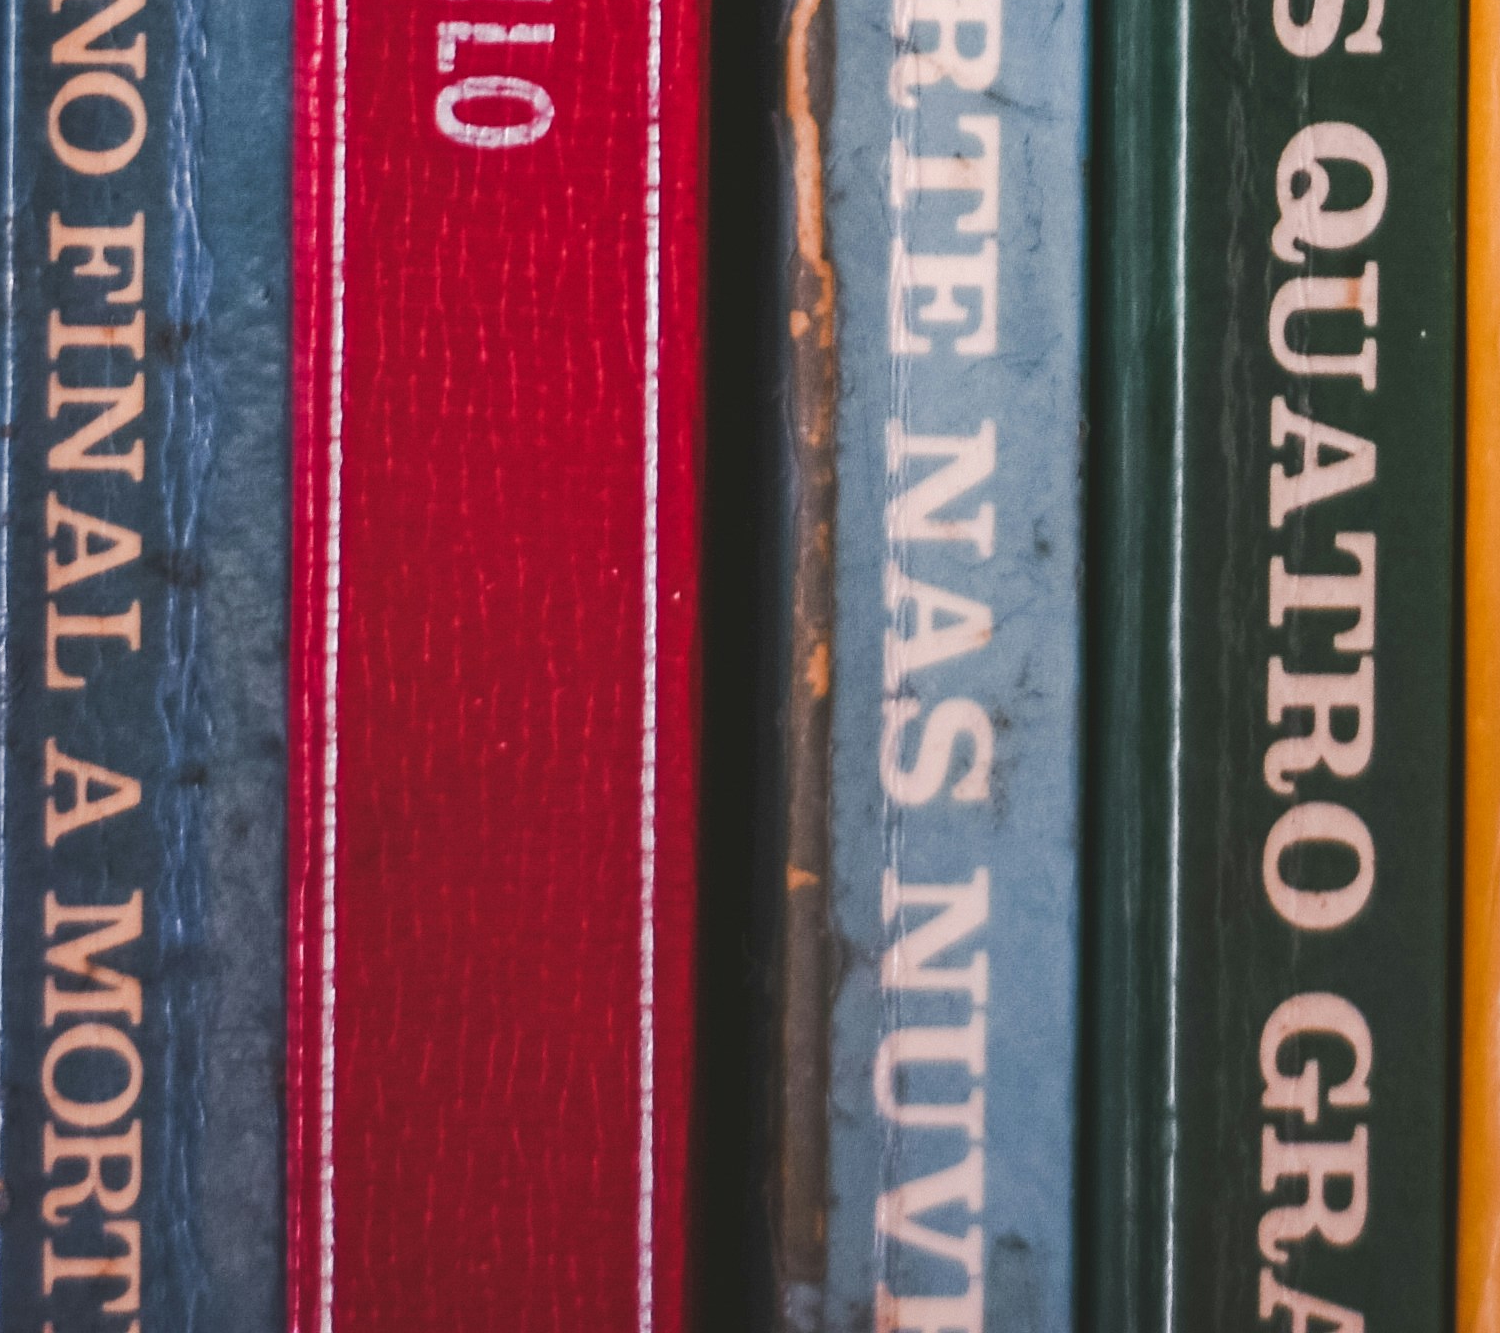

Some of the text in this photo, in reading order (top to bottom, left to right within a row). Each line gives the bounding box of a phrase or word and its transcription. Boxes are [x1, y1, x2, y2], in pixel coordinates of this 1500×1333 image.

[43, 209, 145, 693] FINAL
[878, 417, 997, 808] NAS
[1260, 120, 1388, 931] QUATRO
[43, 739, 142, 846] A
[41, 889, 144, 1333] MORT
